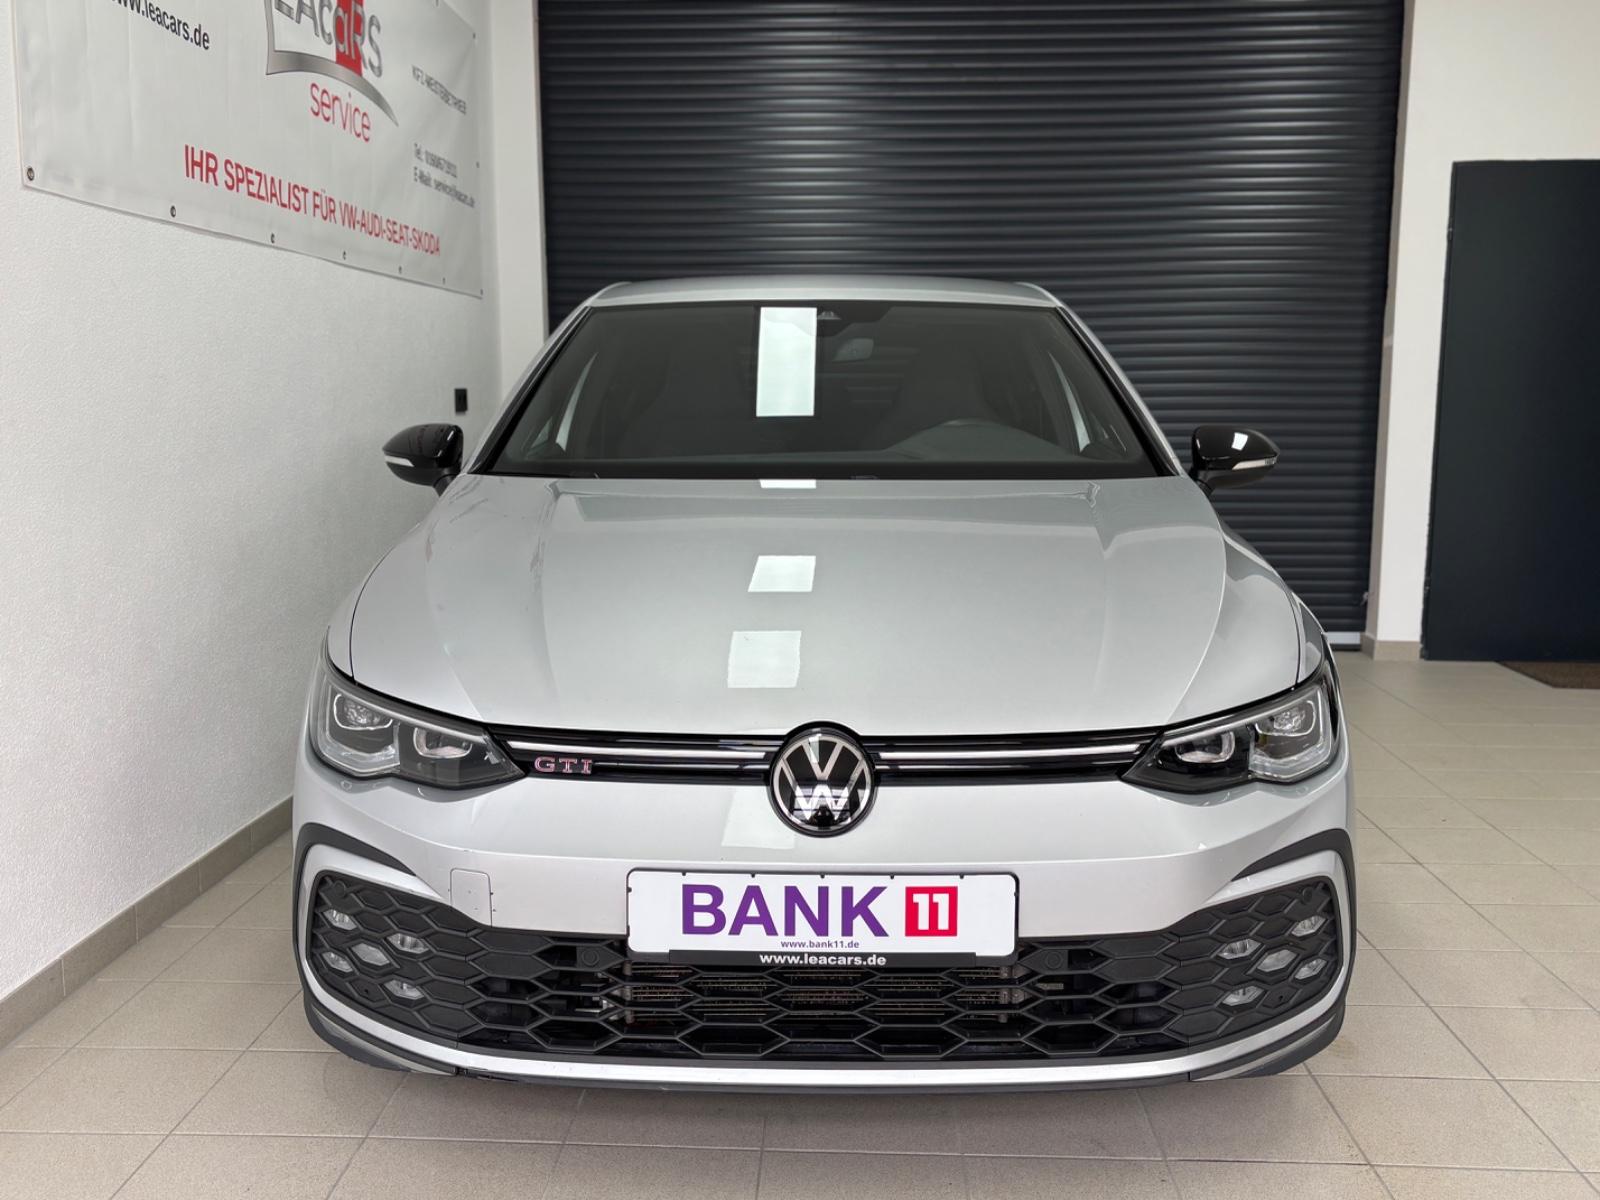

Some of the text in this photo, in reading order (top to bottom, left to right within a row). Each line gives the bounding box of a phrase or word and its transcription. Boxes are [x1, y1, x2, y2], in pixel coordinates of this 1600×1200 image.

[310, 82, 371, 142] service
[184, 143, 219, 187] IHR
[223, 158, 310, 215] SPEZIALIST
[312, 188, 337, 225] FÜR
[534, 756, 594, 775] GTI
[682, 883, 952, 938] BANK 11
[759, 952, 887, 966] www.leacars.de
[780, 940, 860, 949] www.bank11.de
